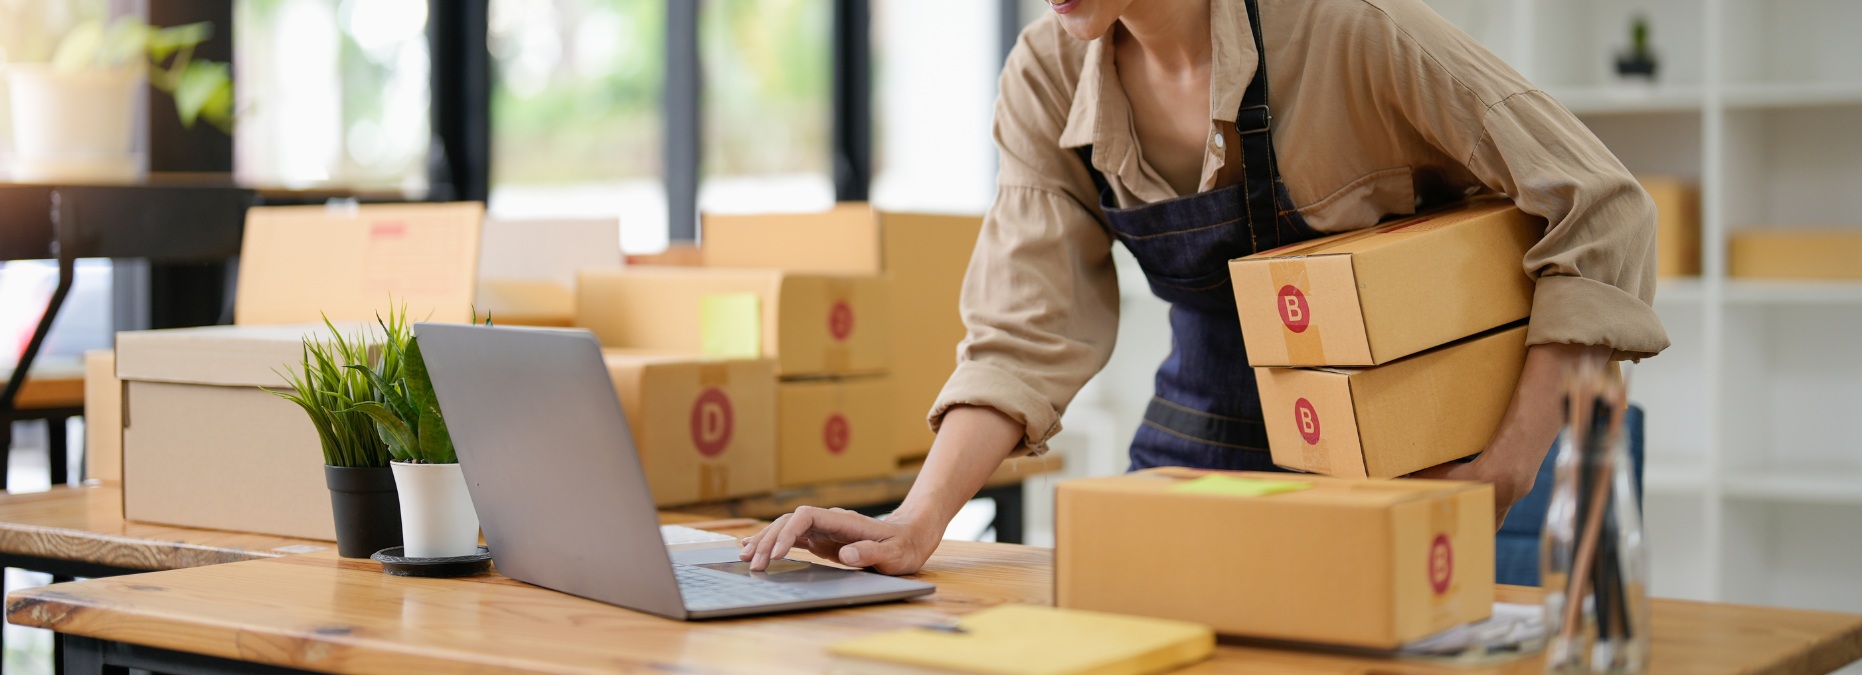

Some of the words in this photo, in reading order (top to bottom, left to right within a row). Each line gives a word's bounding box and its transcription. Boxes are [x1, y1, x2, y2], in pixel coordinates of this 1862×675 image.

[1284, 295, 1302, 321] B
[702, 402, 725, 441] D
[1300, 407, 1314, 433] B
[1433, 544, 1449, 581] B
